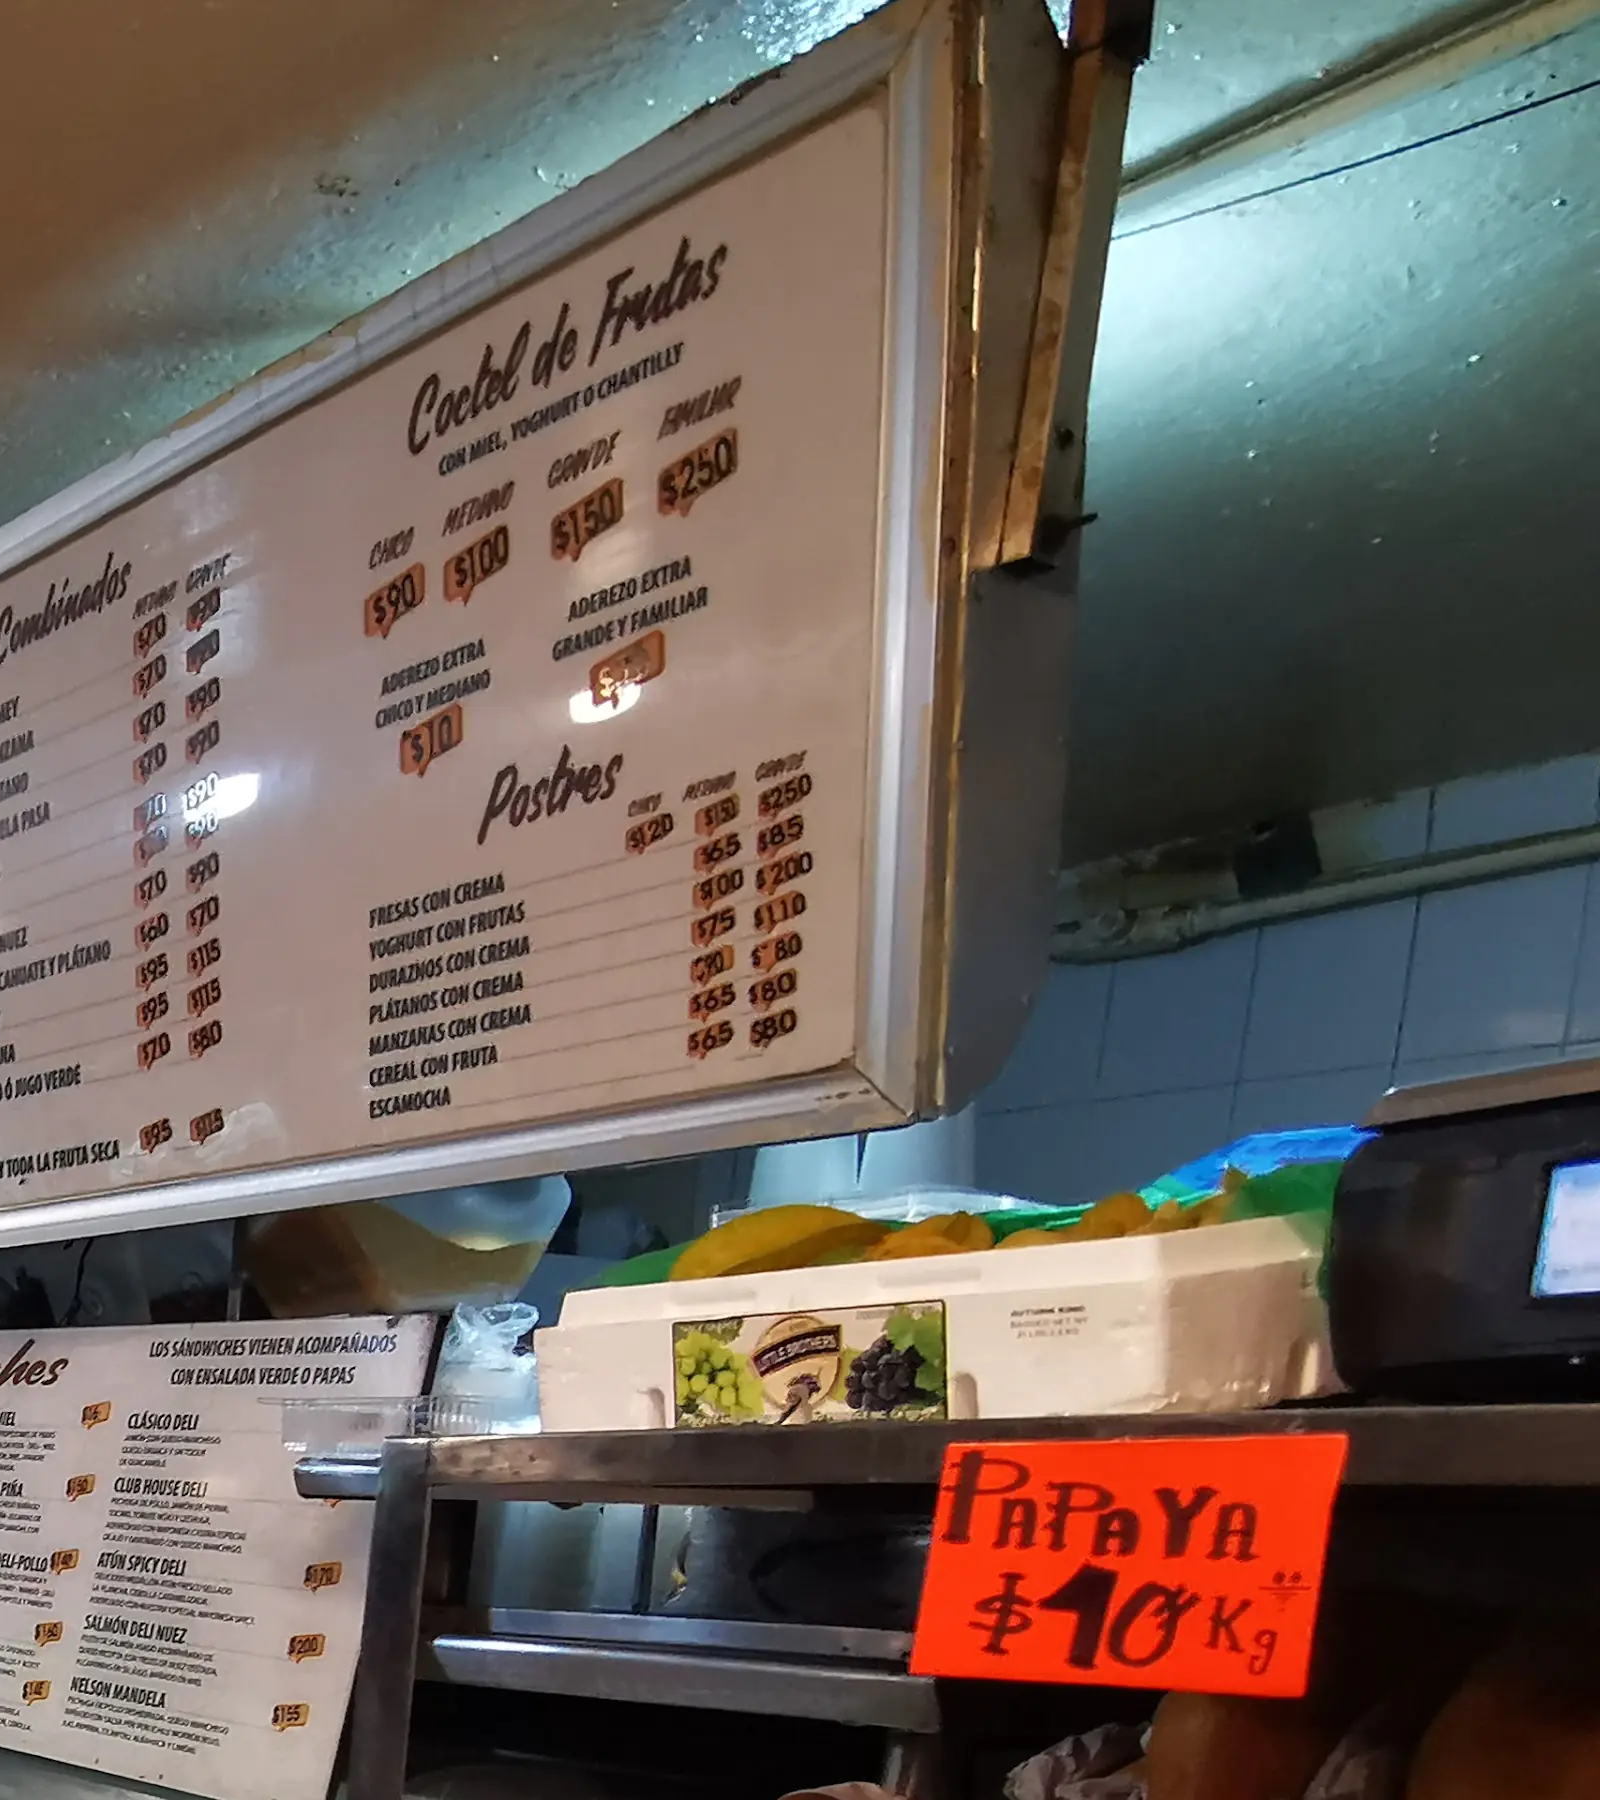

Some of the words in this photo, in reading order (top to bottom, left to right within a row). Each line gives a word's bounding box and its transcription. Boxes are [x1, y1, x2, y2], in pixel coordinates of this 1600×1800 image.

[409, 321, 531, 456] Coctel
[532, 302, 578, 388] de
[588, 236, 728, 367] Frutas
[438, 444, 466, 477] CON
[598, 342, 684, 400] CHANTILLY
[662, 437, 734, 505] $250
[556, 487, 620, 550] $150
[454, 525, 509, 588] $100
[373, 573, 416, 624] $90
[568, 576, 637, 622] ADEREZO
[640, 555, 691, 596] EXTRA
[441, 639, 487, 673] EXTRA
[552, 620, 615, 661] GRANDE
[477, 744, 623, 846] Postres
[761, 774, 812, 814] $250
[759, 814, 804, 850] $85
[369, 896, 419, 928] FRESAS
[422, 887, 450, 914] CON
[454, 870, 505, 905] CREMA
[369, 925, 433, 960] YOGHURT
[436, 918, 466, 943] CON
[468, 900, 526, 935] FRUTAS
[369, 957, 442, 994] DURAZNOS
[446, 947, 475, 975] CON
[478, 935, 530, 966] CREMA
[369, 989, 438, 1025] PLÁTANOS
[440, 984, 469, 1009] CON
[472, 970, 523, 1000] CREMA
[369, 1021, 445, 1057] MANZANAS
[448, 1016, 476, 1039] CON
[480, 1003, 532, 1033] CREMA
[45, 1064, 81, 1091] VERDE
[369, 1060, 418, 1088] CEREAL
[421, 1054, 449, 1078] CON
[451, 1042, 498, 1072] FRUTA
[370, 1086, 451, 1120] ESCAMOCHA
[7, 1155, 34, 1178] TODA
[36, 1153, 50, 1171] LA
[53, 1147, 89, 1172] FRUTA
[91, 1139, 120, 1164] SECA
[149, 1341, 169, 1358] LOS
[171, 1337, 249, 1357] SÁNDWICHES
[248, 1337, 293, 1355] VIENEN
[295, 1331, 398, 1355] ACOMPAÑADOS
[171, 1368, 192, 1385] CON
[195, 1367, 256, 1385] ENSALADA
[258, 1367, 300, 1385] VERDE
[311, 1366, 357, 1384] PAPAS
[128, 1411, 171, 1430] CLÁSICO
[173, 1414, 199, 1430] DELI
[114, 1476, 141, 1493] CLUB
[143, 1479, 179, 1496] HOUSE
[181, 1481, 207, 1498] DELI
[942, 1451, 1260, 1562] PAPAYA
[97, 1551, 125, 1569] ATÚN
[126, 1555, 160, 1573] SPICY
[161, 1559, 187, 1577] DELI
[83, 1614, 127, 1634] SALMÓN
[129, 1620, 156, 1640] DELI
[157, 1624, 189, 1644] NUEZ
[1204, 1592, 1278, 1674] Kg
[70, 1676, 110, 1697] NELSON
[112, 1684, 167, 1708] MANDELA
